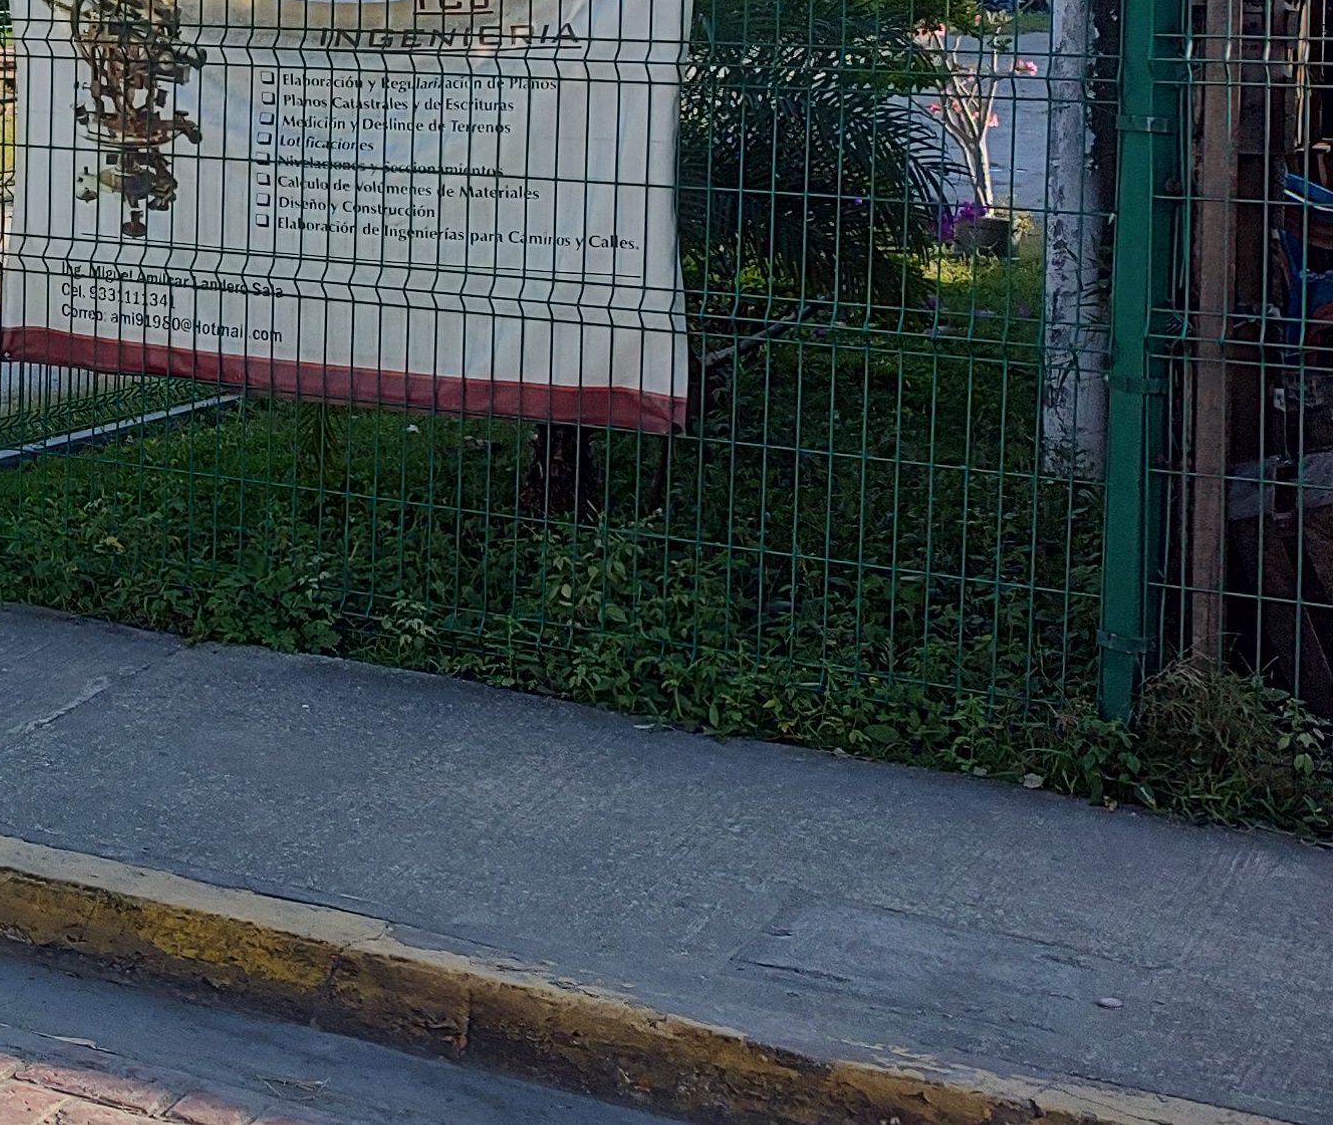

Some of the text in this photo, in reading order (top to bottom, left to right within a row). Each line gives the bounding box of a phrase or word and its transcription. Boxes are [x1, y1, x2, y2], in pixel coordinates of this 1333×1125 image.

[318, 22, 579, 49] INGENIERIA
[282, 73, 362, 89] Elaboración
[367, 78, 376, 93] y
[487, 76, 504, 89] de
[509, 77, 557, 90] Planos
[283, 93, 328, 108] Planos
[332, 96, 409, 110] Catastrales
[424, 97, 441, 111] de
[445, 97, 514, 112] Escrituras
[282, 115, 511, 134] Medición y Deslinde de Terrenos
[279, 134, 374, 151] Lotficaciones
[333, 179, 351, 192] de
[437, 183, 454, 198] de
[459, 184, 540, 200] Materiales
[278, 196, 435, 218] Diseño y Construcción
[277, 217, 356, 234] Elaboración
[362, 222, 380, 236] de
[384, 226, 464, 242] Ingenierías
[470, 231, 504, 246] para
[508, 230, 571, 246] Caminos
[575, 236, 584, 251] y
[110, 312, 282, 343] ami91980@Hotmai.com
